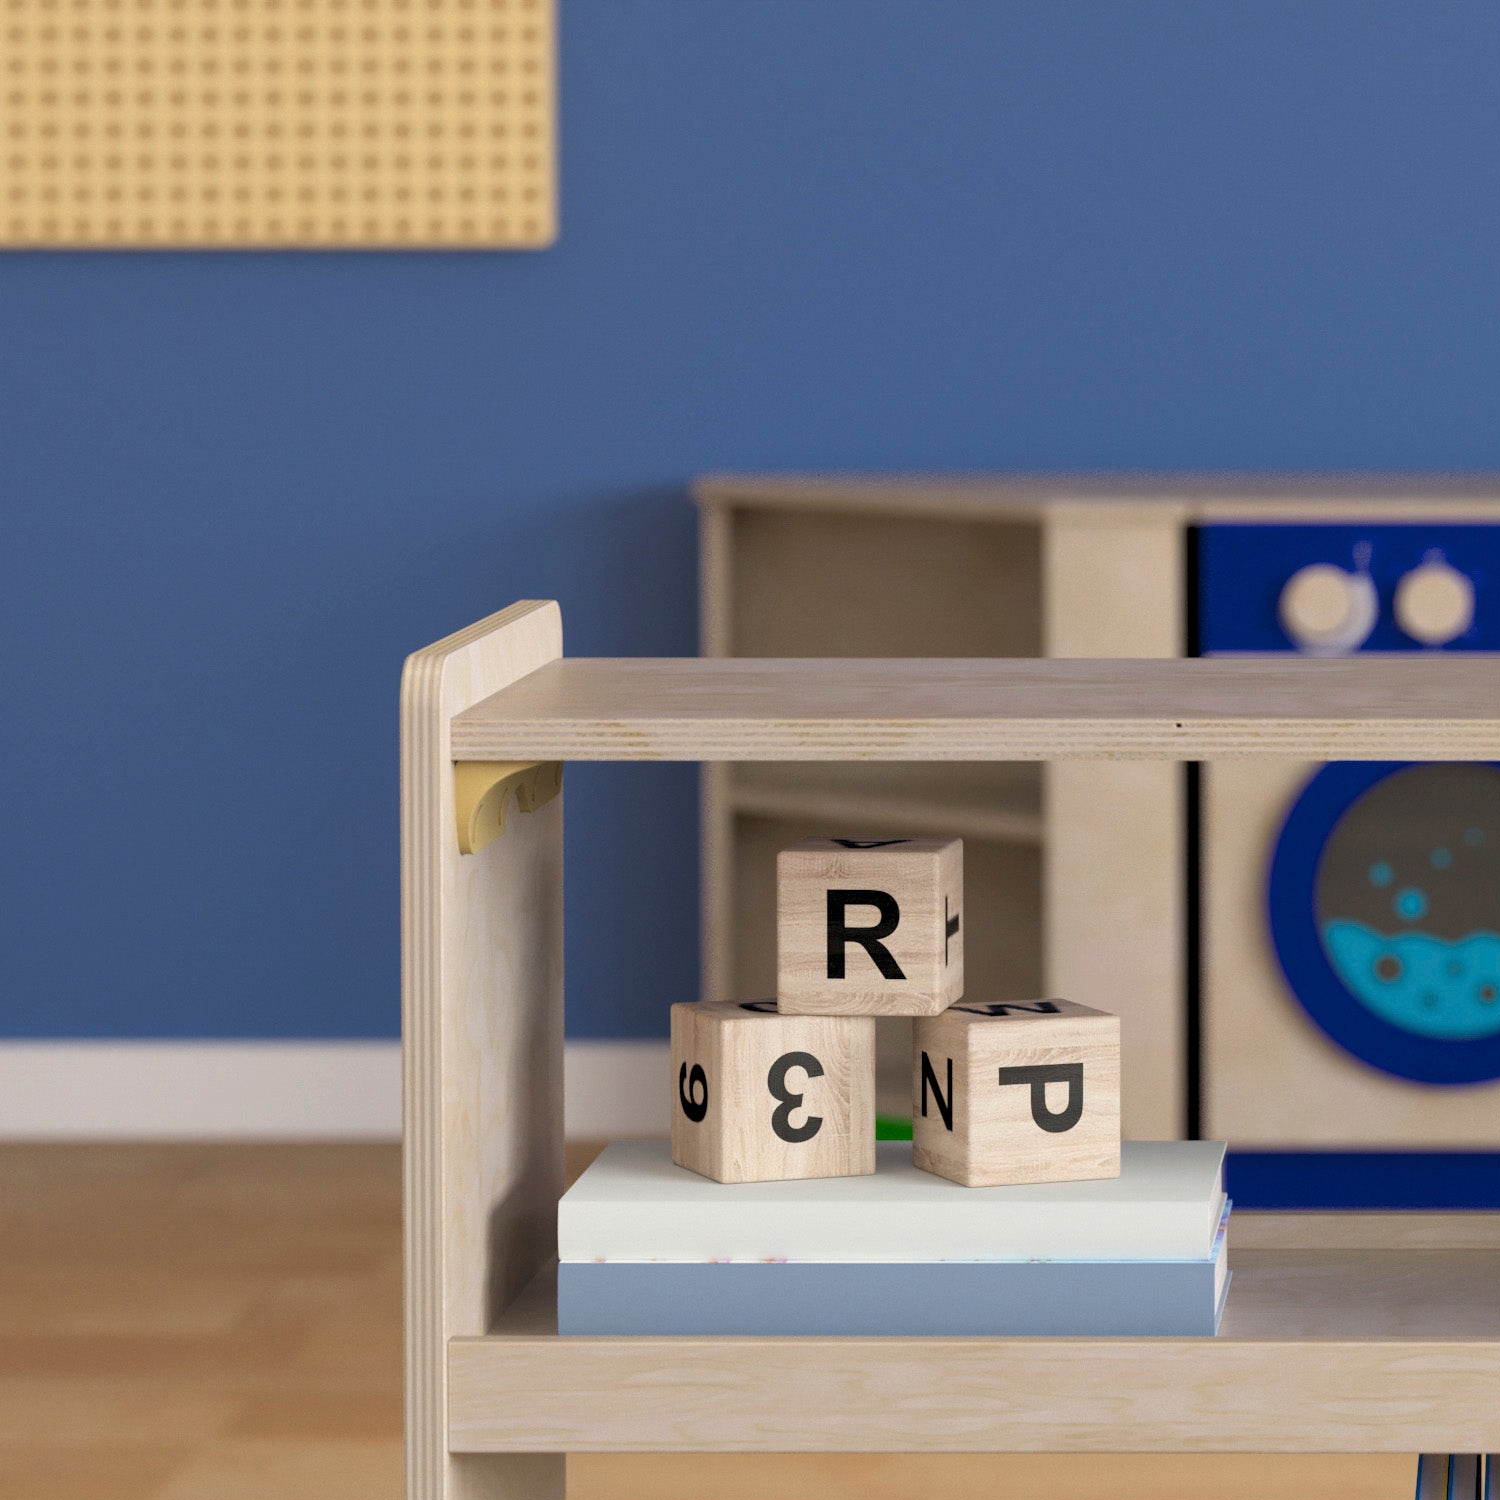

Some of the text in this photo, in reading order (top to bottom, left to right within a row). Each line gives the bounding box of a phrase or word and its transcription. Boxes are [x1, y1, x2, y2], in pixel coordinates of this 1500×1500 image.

[826, 889, 907, 980] R
[921, 1051, 953, 1132] N
[998, 1062, 1084, 1133] P
